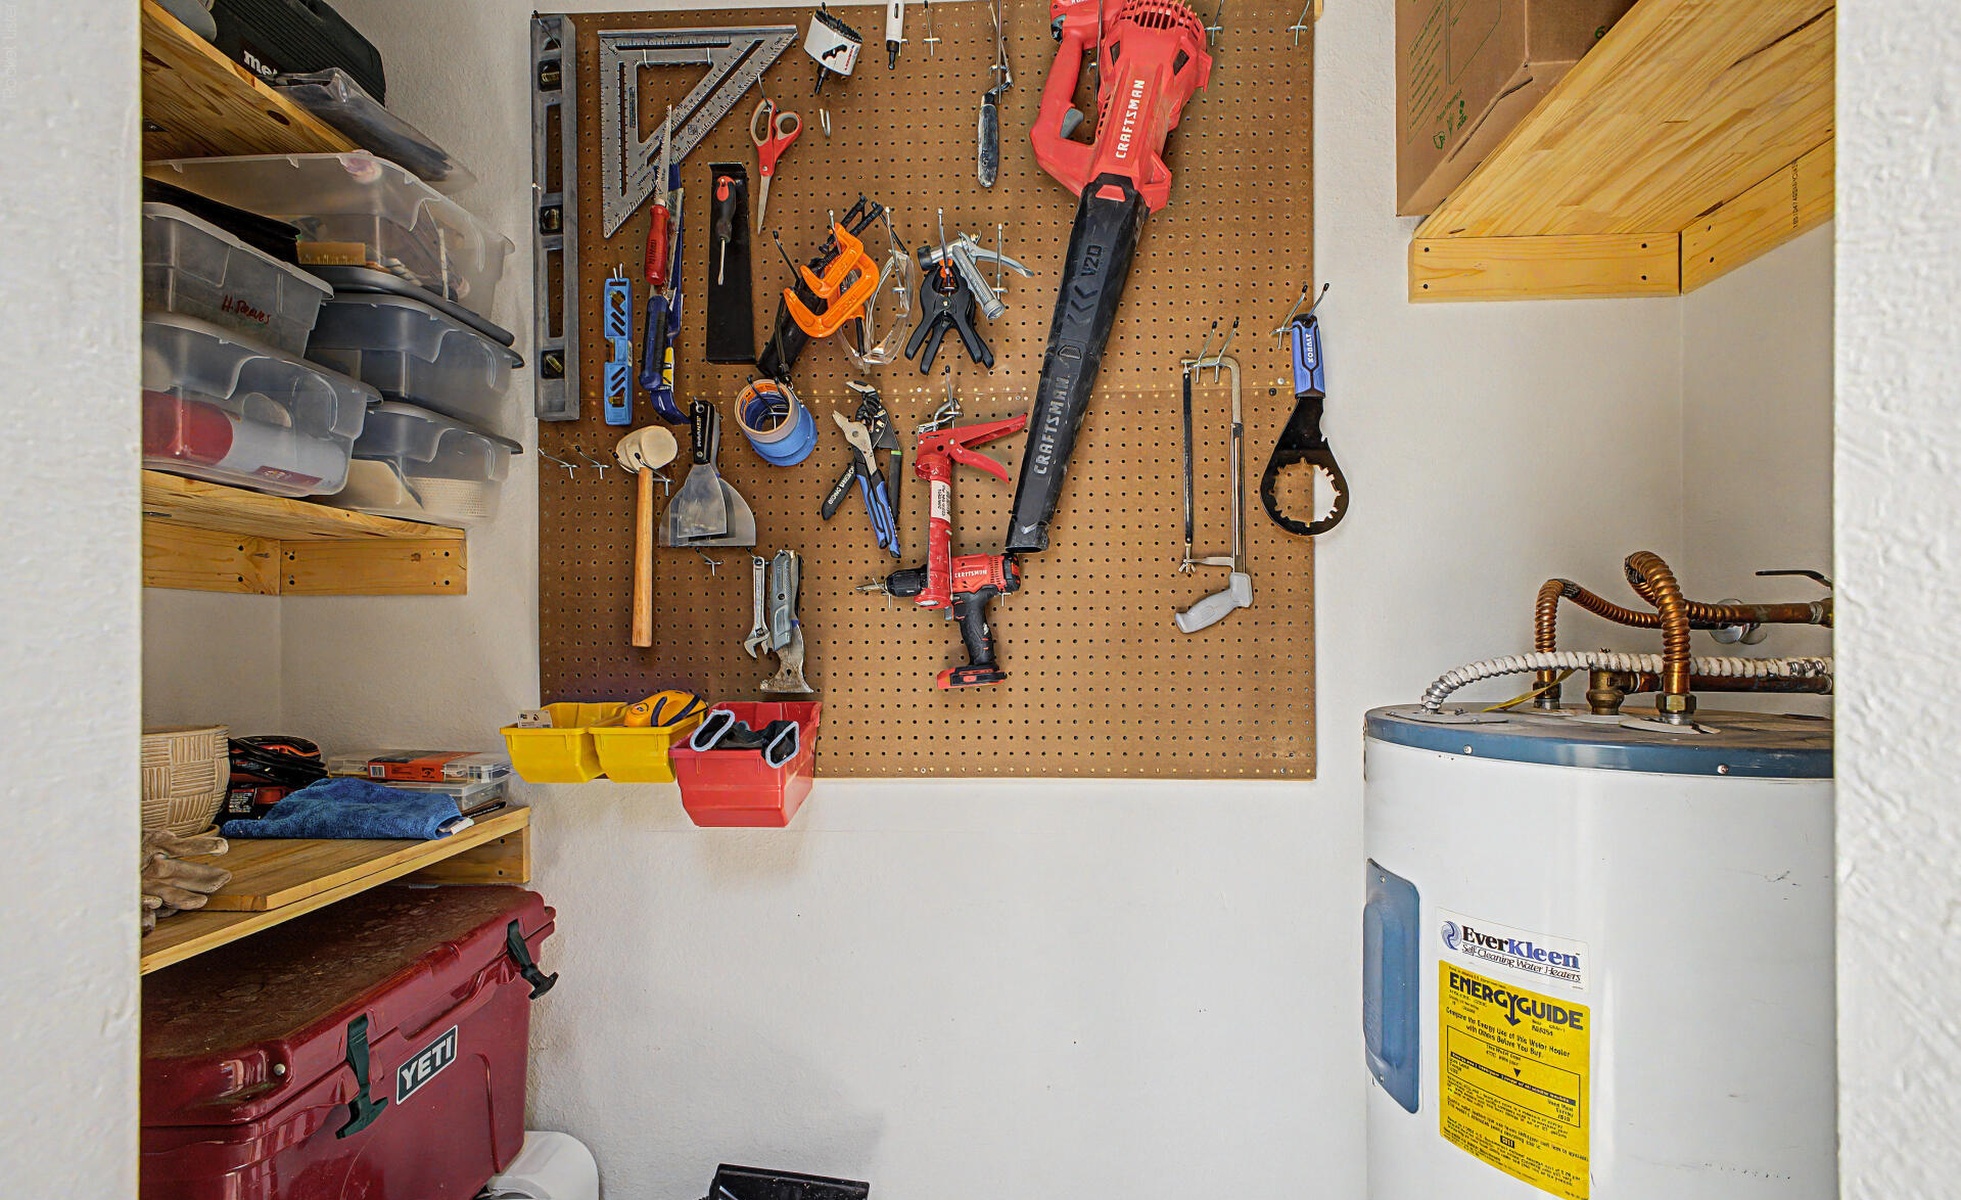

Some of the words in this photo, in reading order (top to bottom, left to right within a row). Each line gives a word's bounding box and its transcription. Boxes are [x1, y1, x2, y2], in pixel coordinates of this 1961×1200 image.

[1115, 79, 1146, 159] CRAFTSMAN
[1081, 244, 1103, 277] V20
[1305, 333, 1314, 363] KOBALT
[1033, 376, 1071, 476] CRAFTSMAN
[1462, 925, 1581, 969] EverKleen
[1516, 959, 1544, 973] Water
[1545, 964, 1582, 982] Heaters
[1446, 1006, 1467, 1021] Compare
[1468, 1016, 1476, 1024] the
[1477, 1020, 1495, 1034] Energy
[1449, 971, 1584, 1031] ENERGYGUIDE
[401, 1034, 454, 1091] YETI
[1517, 1043, 1529, 1052] You
